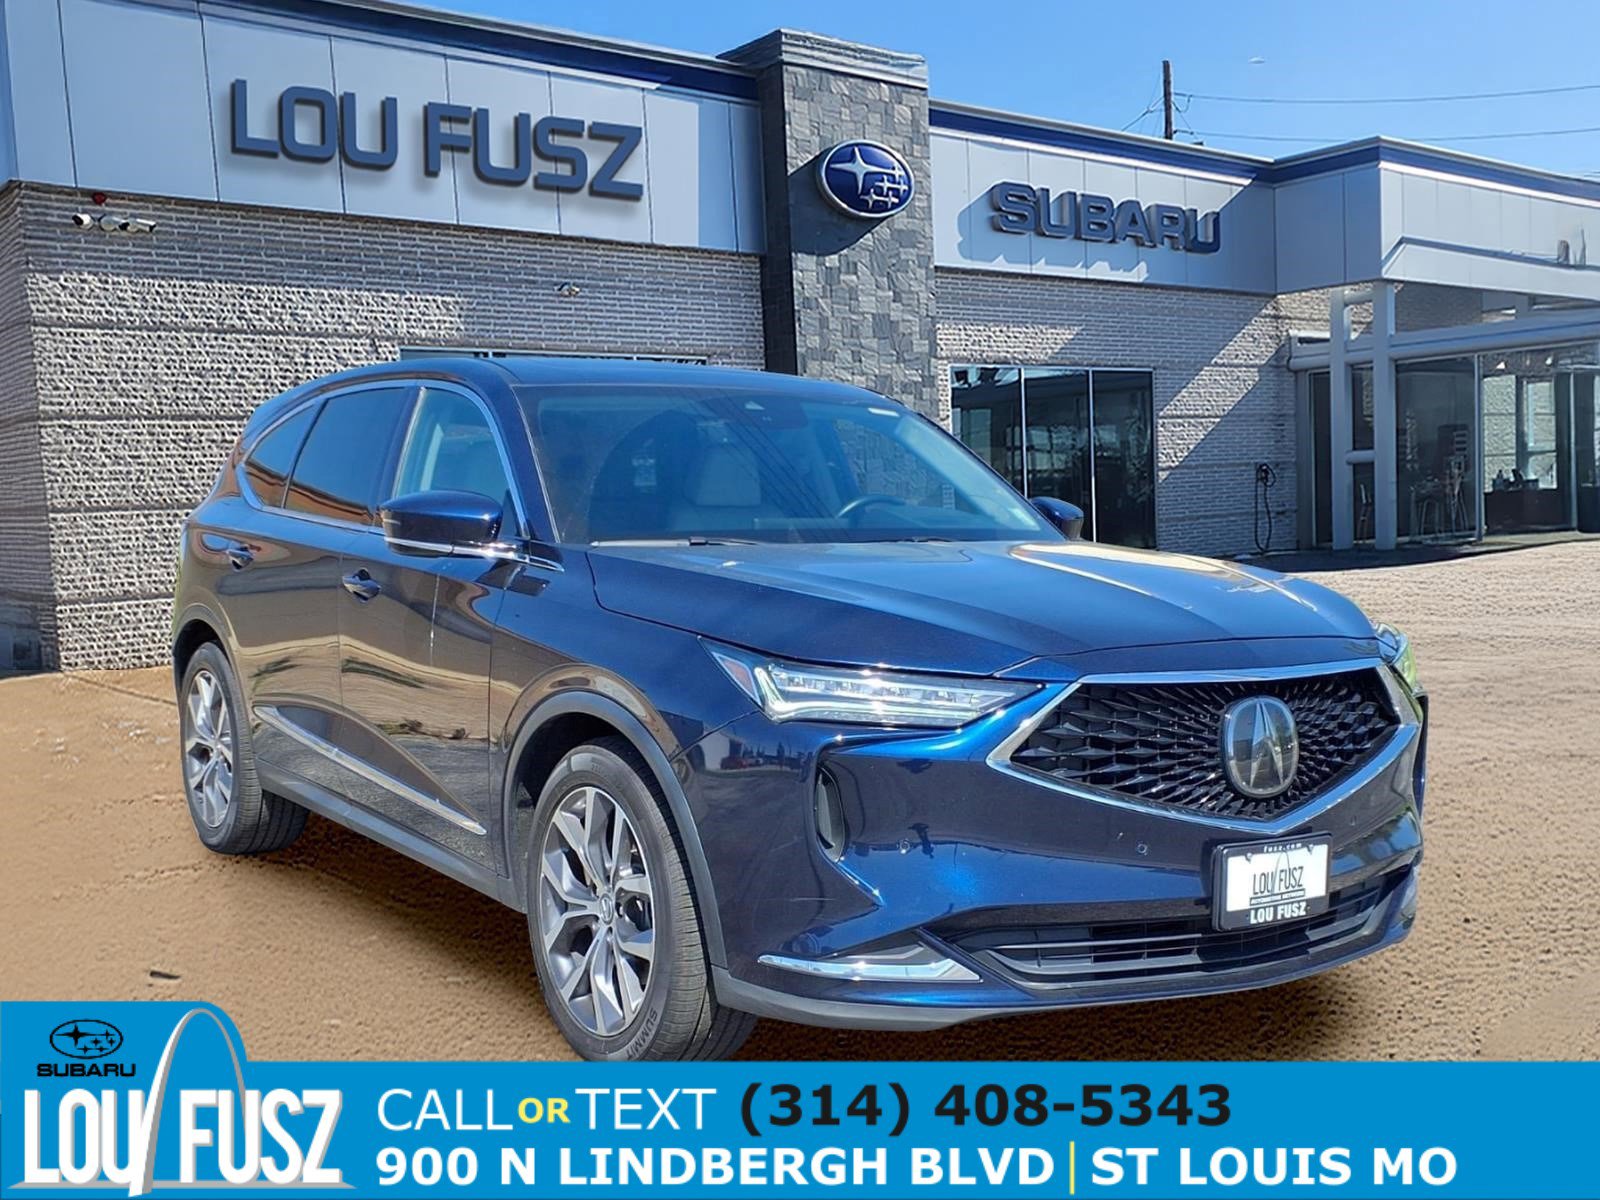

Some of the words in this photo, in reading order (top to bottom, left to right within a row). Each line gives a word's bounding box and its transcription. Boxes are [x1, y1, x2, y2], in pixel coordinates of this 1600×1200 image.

[231, 78, 398, 170] LOU
[424, 101, 645, 200] FUSZ
[992, 181, 1221, 255] SUBARU
[1252, 871, 1274, 896] LOU
[1278, 866, 1304, 891] FUSZ
[1249, 906, 1274, 925] LOU
[1276, 901, 1307, 920] FUSZ
